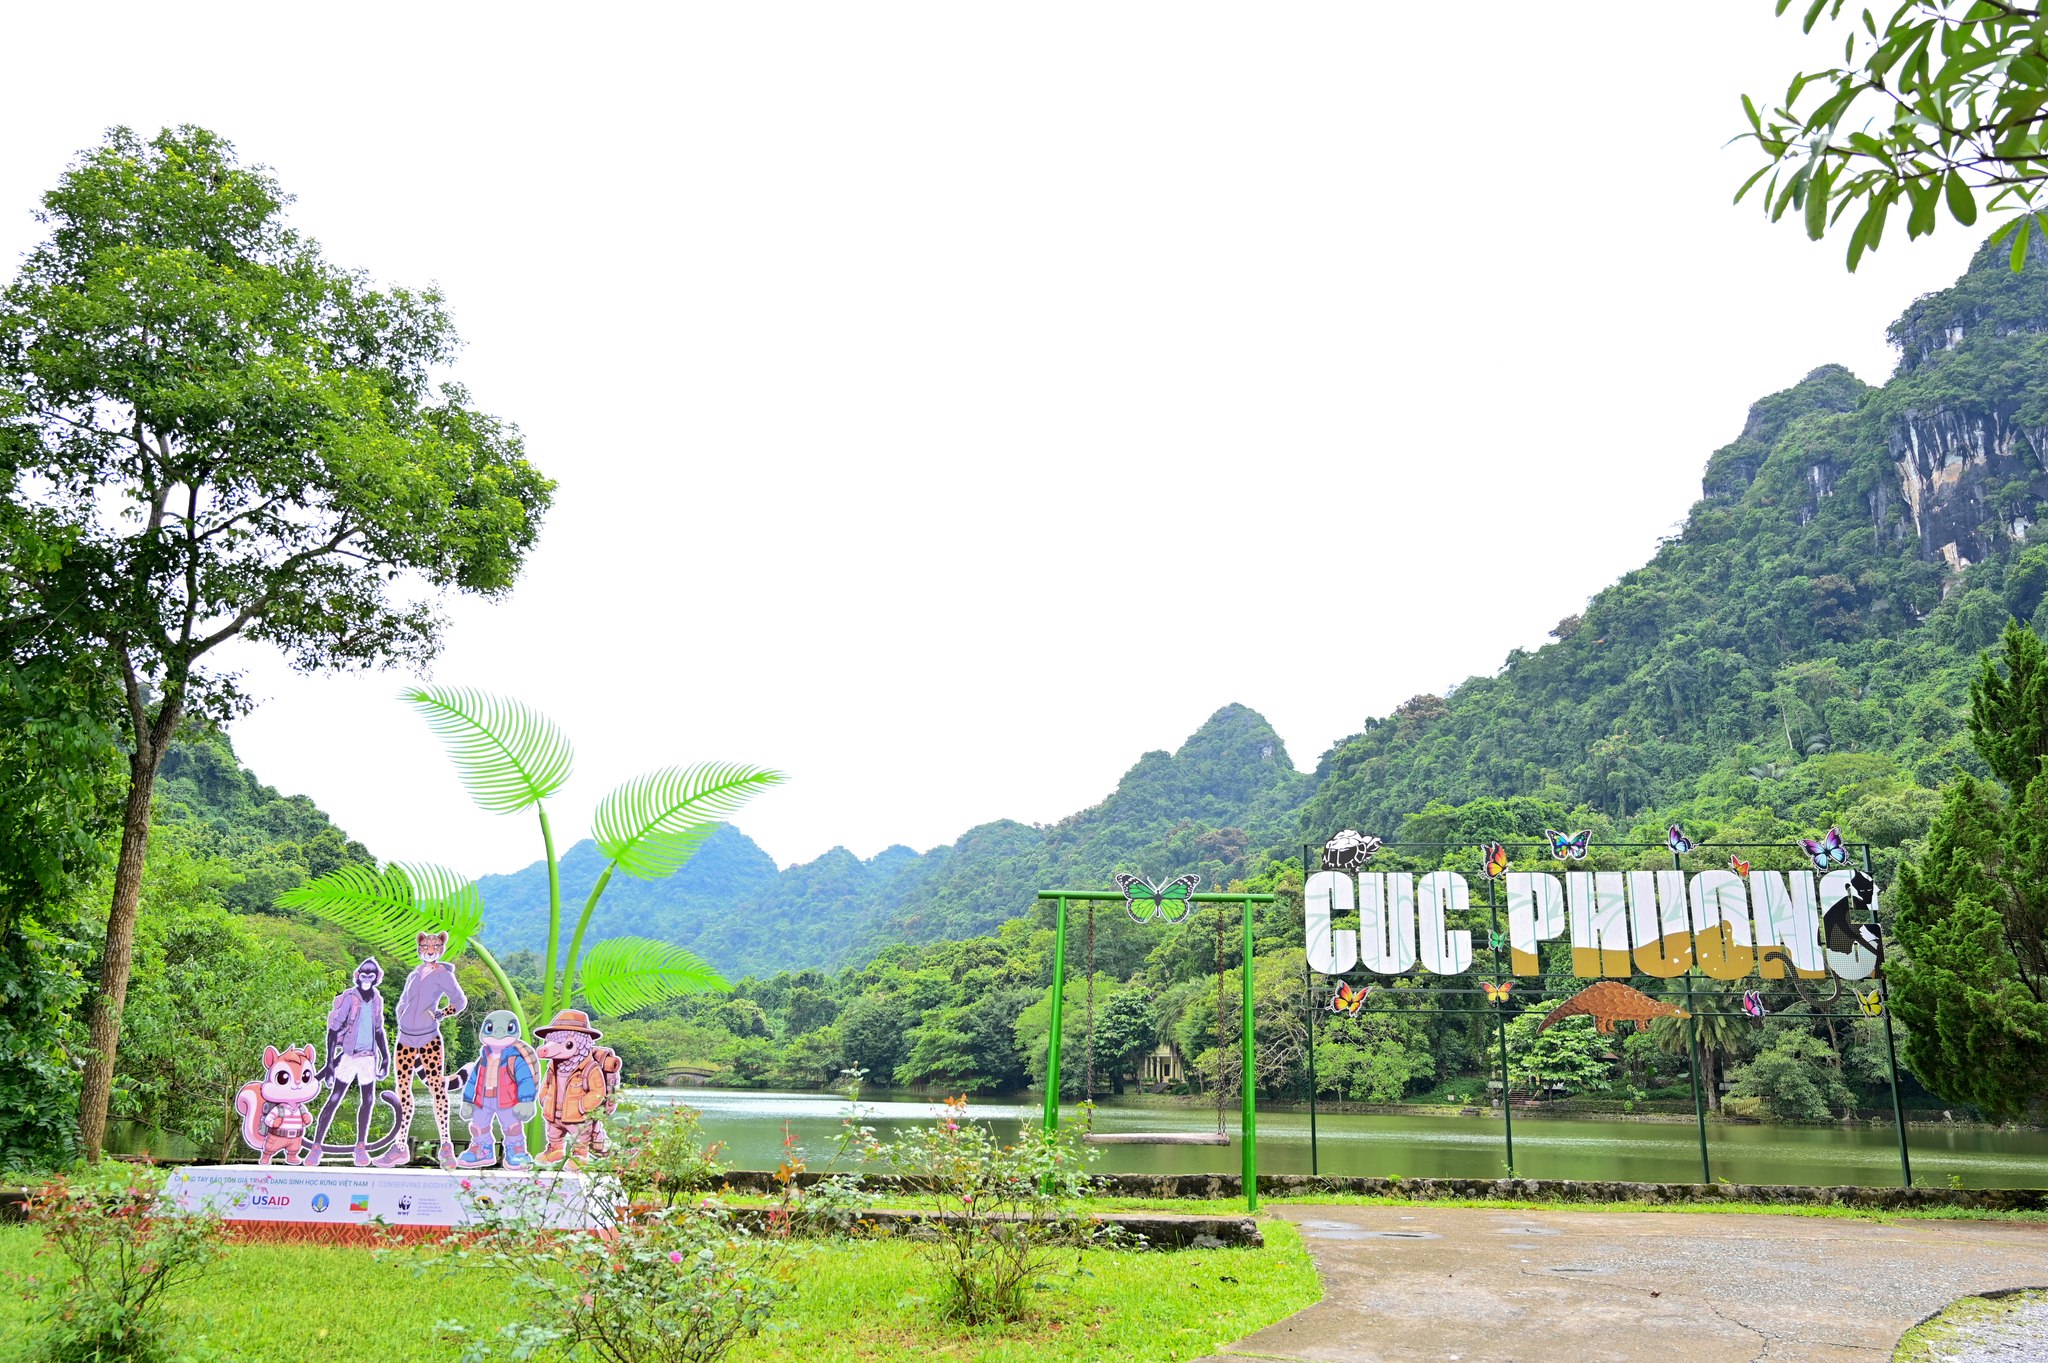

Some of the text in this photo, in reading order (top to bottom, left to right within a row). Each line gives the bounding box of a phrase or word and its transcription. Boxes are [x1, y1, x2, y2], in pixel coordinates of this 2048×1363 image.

[305, 1179, 319, 1187] HỌC
[338, 1179, 353, 1188] VIỆT
[252, 1196, 290, 1206] USAID
